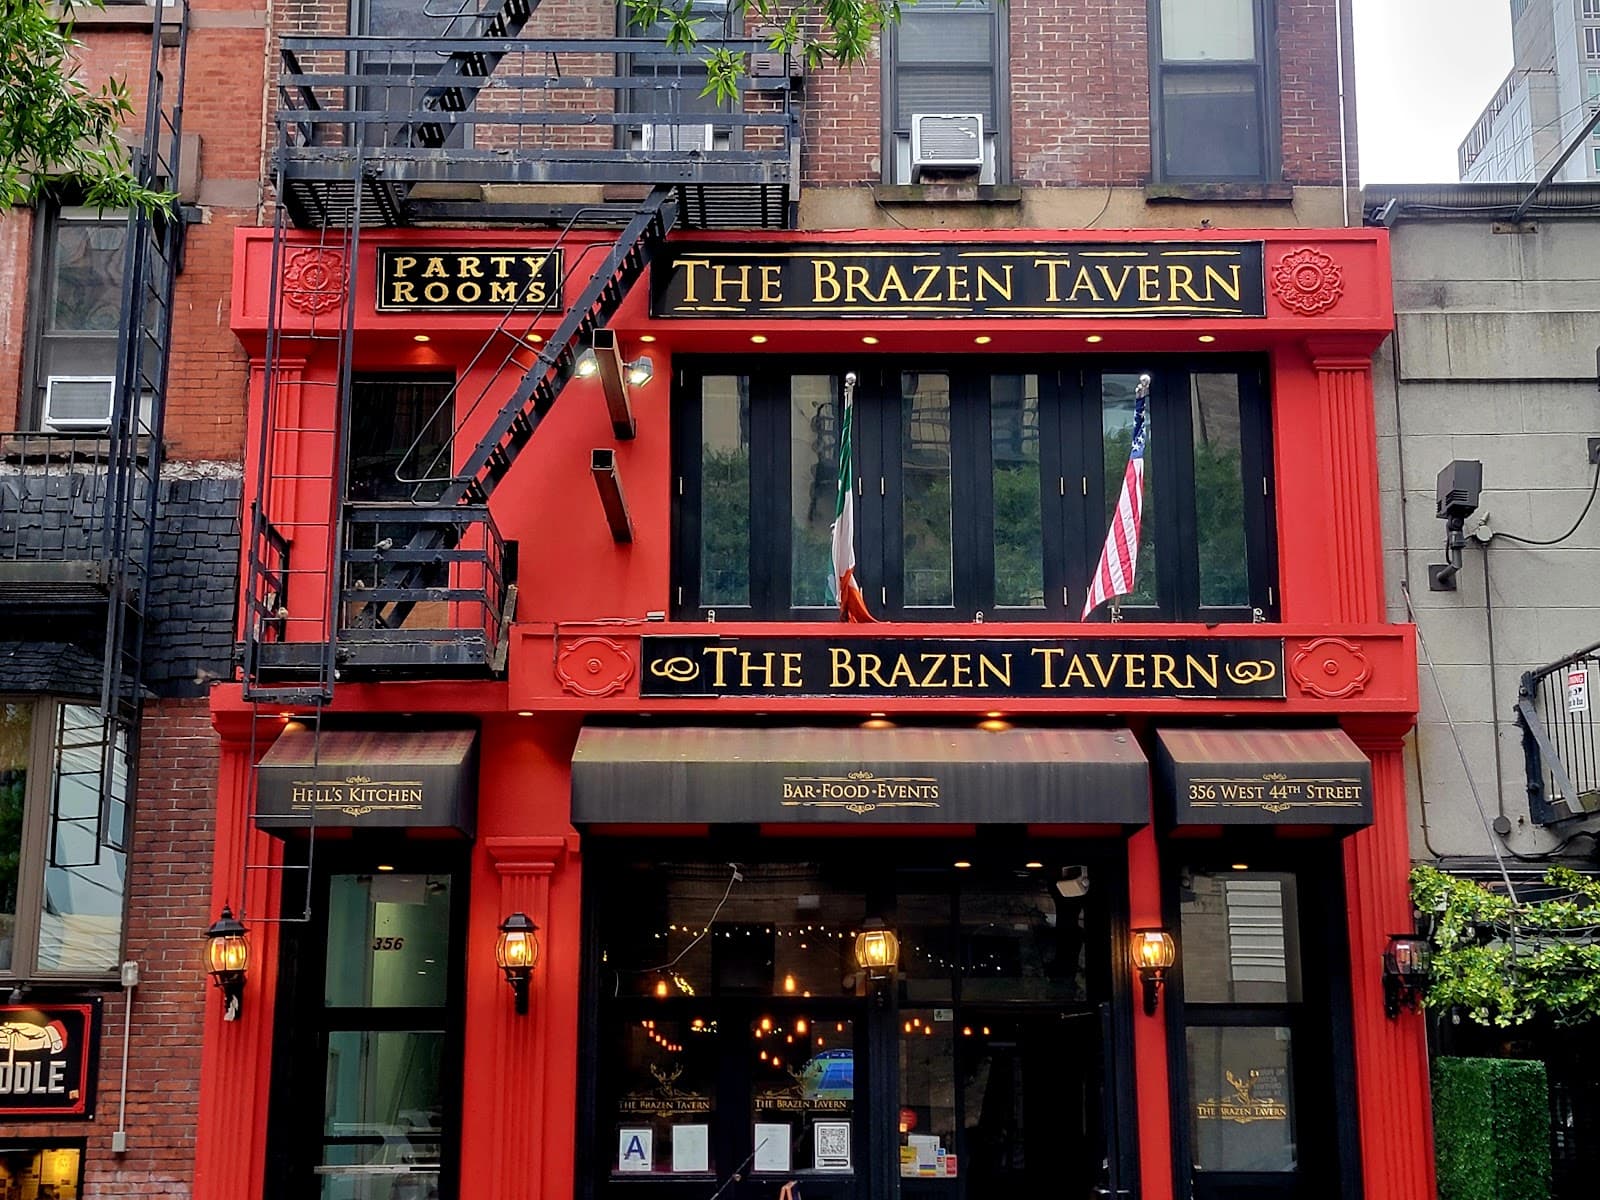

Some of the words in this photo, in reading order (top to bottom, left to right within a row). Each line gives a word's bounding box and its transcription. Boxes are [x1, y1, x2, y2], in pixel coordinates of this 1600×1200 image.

[391, 256, 548, 279] PARTY
[672, 259, 783, 302] THE
[811, 260, 1014, 303] BRAZEN
[1034, 260, 1241, 303] TAVERN
[392, 281, 547, 303] ROOMS
[703, 647, 803, 688] THE
[829, 648, 1012, 689] BRAZEN
[1031, 648, 1220, 689] TAVERN
[349, 787, 423, 802] KITCHEN
[1189, 784, 1216, 800] 356
[1219, 784, 1264, 799] WEST
[1269, 784, 1301, 799] 44TH
[1306, 784, 1362, 799] STREET
[372, 937, 404, 950] 356
[754, 1100, 773, 1108] THE
[777, 1100, 810, 1109] BRAZEN
[813, 1100, 847, 1108] TAVERN
[1197, 1106, 1215, 1116] THE
[1254, 1107, 1287, 1116] TAVERN
[624, 1135, 646, 1160] A
